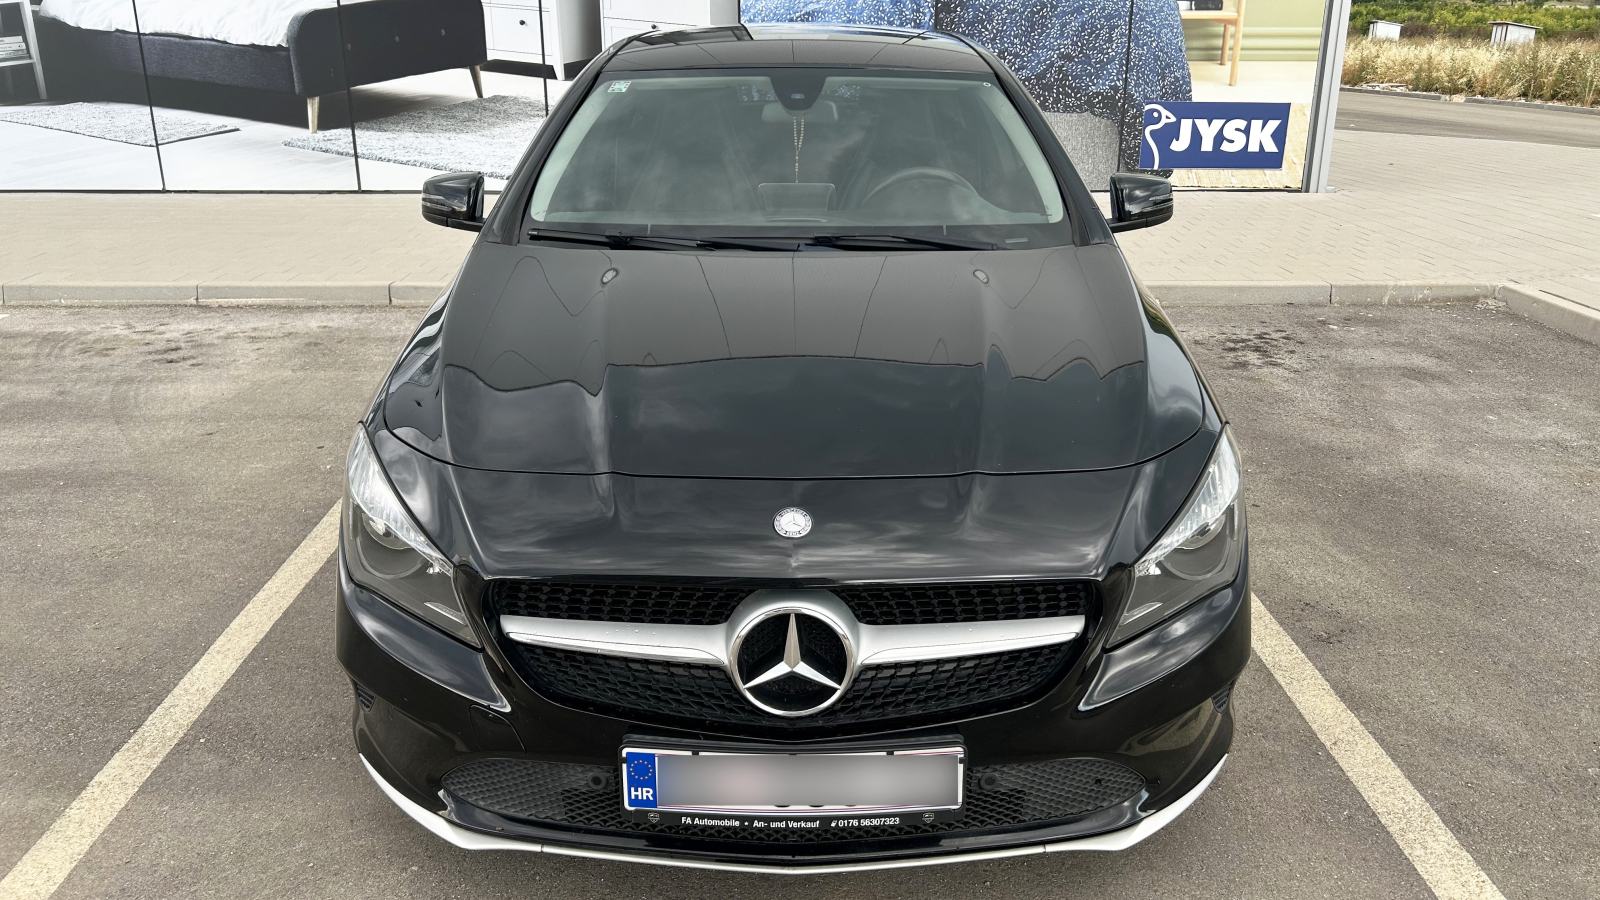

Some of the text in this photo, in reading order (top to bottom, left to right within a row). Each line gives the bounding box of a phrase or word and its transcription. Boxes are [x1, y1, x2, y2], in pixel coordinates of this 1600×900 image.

[1169, 118, 1282, 153] JYSK
[630, 786, 654, 801] HR
[681, 816, 900, 828] FA Automobile An- und Verkauf 0176 56307323
